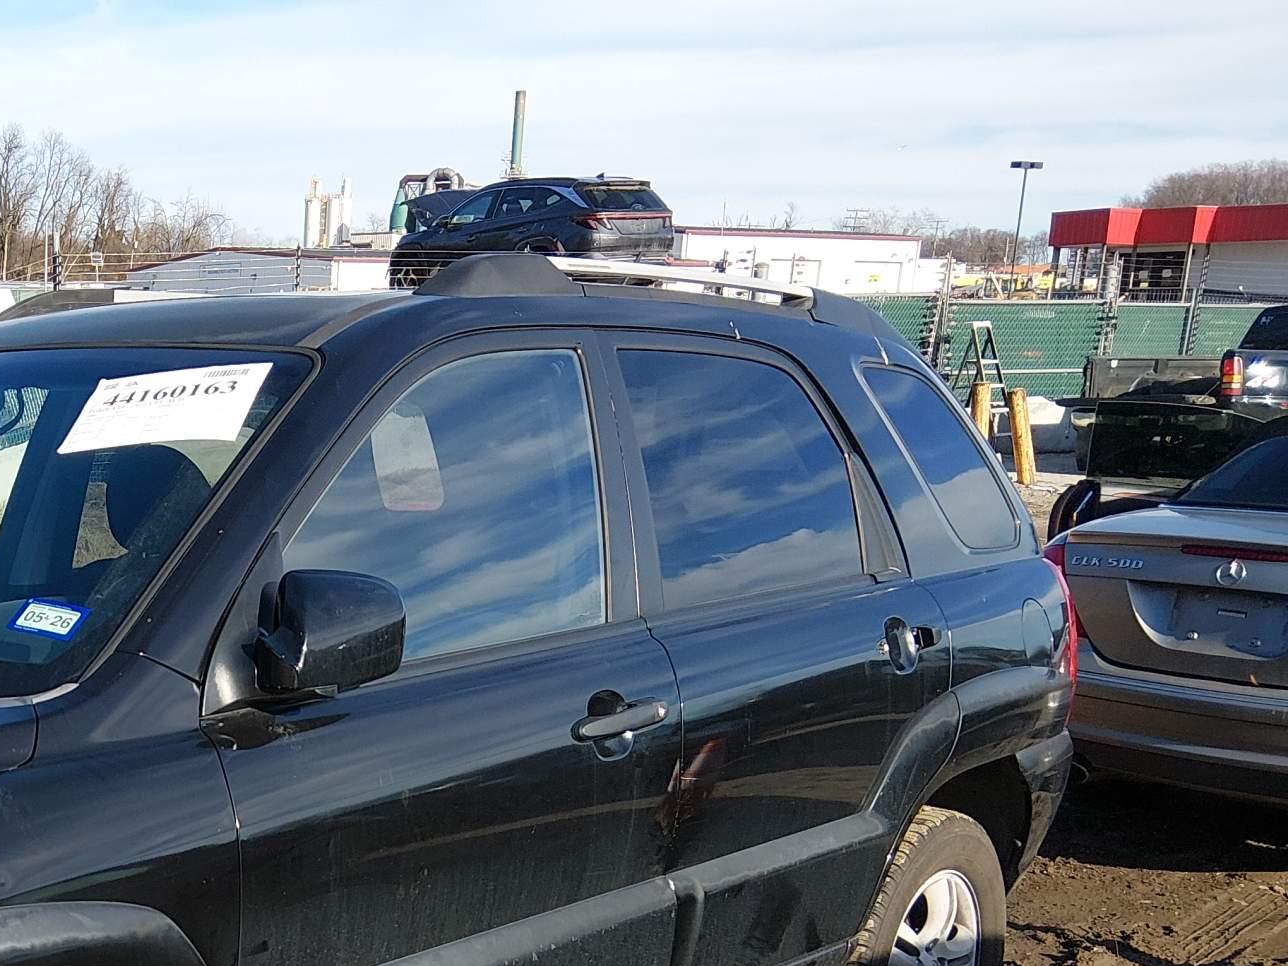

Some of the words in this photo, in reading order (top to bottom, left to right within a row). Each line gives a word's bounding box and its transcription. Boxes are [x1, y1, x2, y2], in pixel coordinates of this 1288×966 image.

[103, 380, 239, 407] 44160163
[1071, 555, 1102, 567] CLK
[1106, 558, 1145, 569] 500
[23, 610, 47, 624] 05
[49, 615, 73, 629] 26
